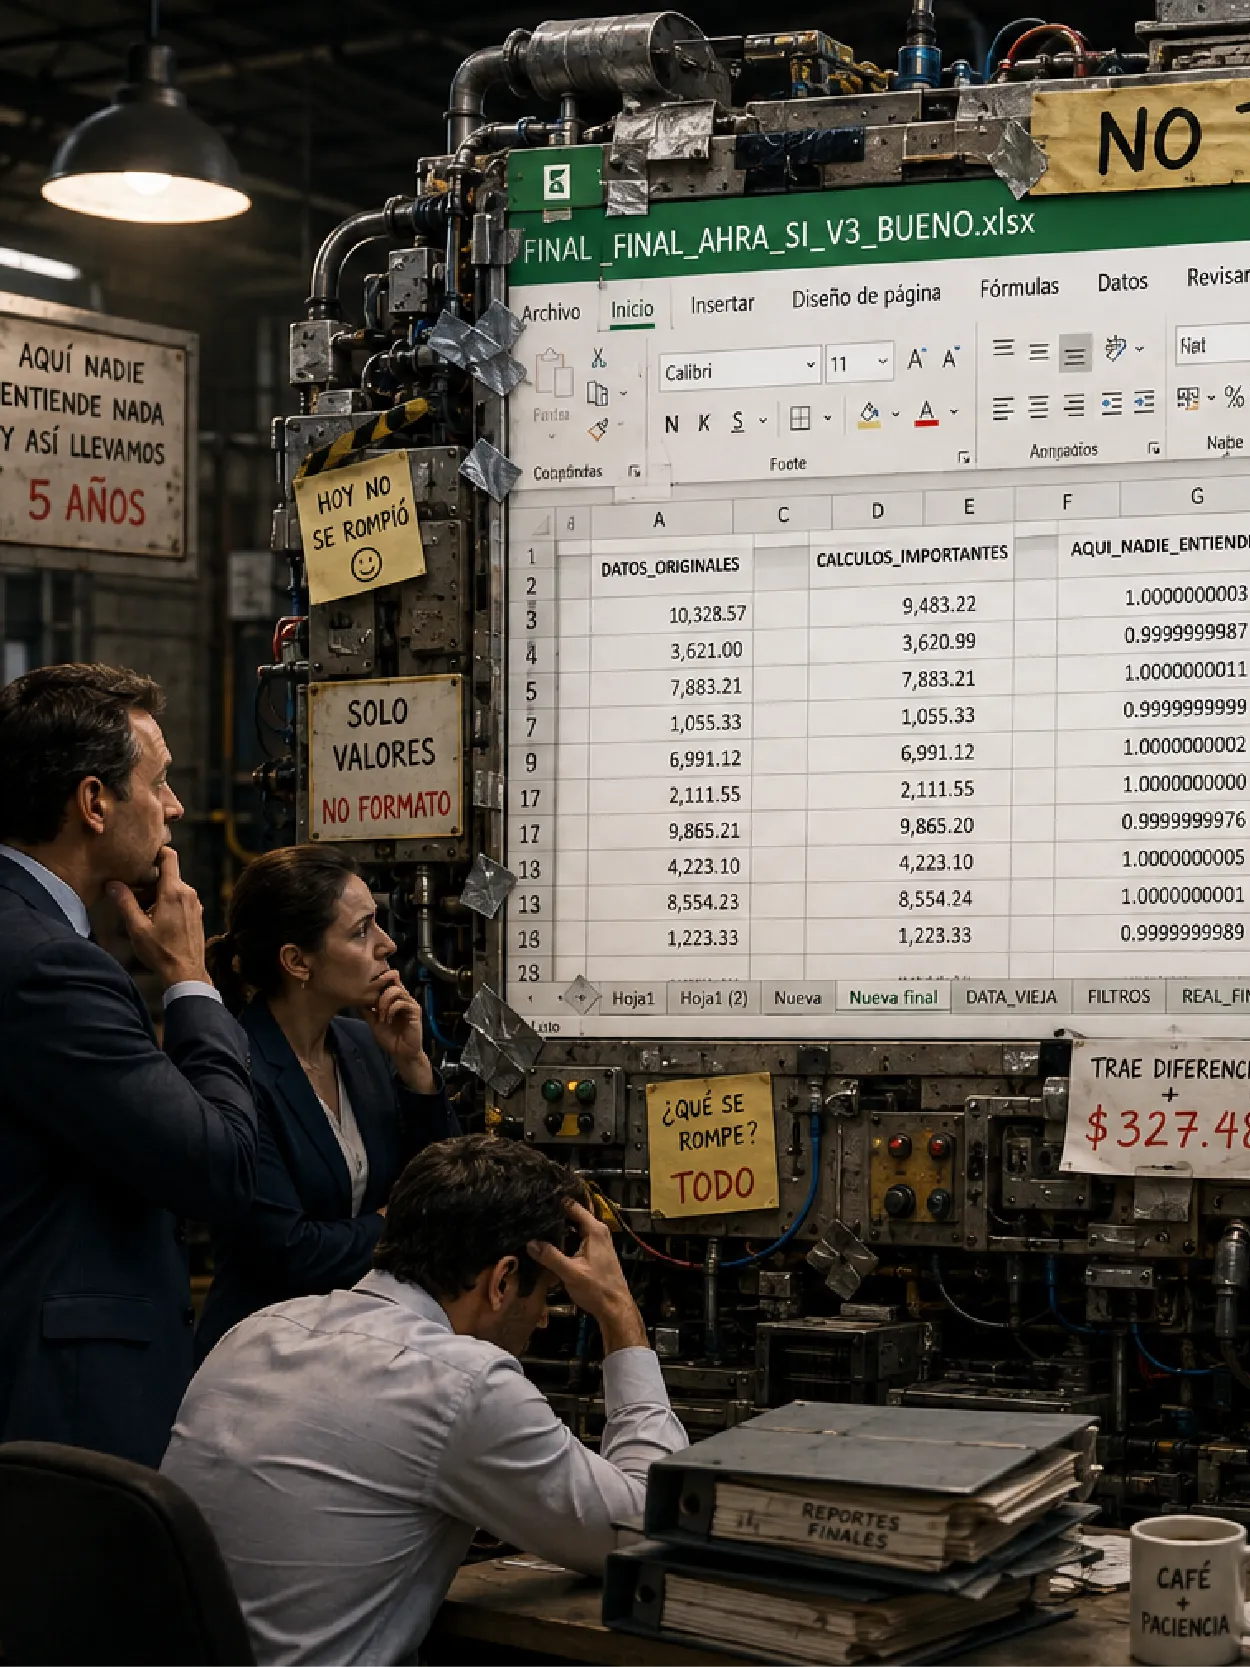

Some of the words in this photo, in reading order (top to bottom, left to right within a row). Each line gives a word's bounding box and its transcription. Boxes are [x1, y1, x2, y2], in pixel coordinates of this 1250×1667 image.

[1099, 106, 1203, 175] NO
[524, 237, 592, 264] FINAL
[523, 303, 581, 323] Archivo
[612, 299, 653, 317] Inicio
[692, 296, 754, 314] Insertar
[793, 289, 851, 309] Diseño
[858, 287, 878, 306] de
[884, 284, 940, 307] página
[981, 278, 1059, 299] Fórmulas
[1099, 274, 1147, 291] Datos
[1188, 266, 1250, 286] Revisar
[19, 342, 73, 373] AQUÍ
[85, 355, 144, 383] NADIE
[666, 363, 711, 380] Calibri
[831, 357, 845, 372] 11
[2, 382, 101, 418] ENTIENDE
[114, 398, 164, 426] NADA
[25, 425, 60, 454] ASÍ
[70, 434, 164, 466] LLEVAMOS
[29, 479, 50, 520] 5
[65, 476, 144, 527] AÑOS
[318, 484, 354, 514] HOY
[366, 476, 390, 499] NO
[653, 512, 665, 527] A
[779, 507, 789, 522] C
[873, 502, 884, 519] D
[965, 499, 974, 514] E
[1192, 487, 1203, 504] G
[313, 527, 334, 550] SE
[344, 500, 409, 543] ROMPIÓ
[602, 557, 739, 578] DATOS_ORIGINALES
[817, 545, 1008, 567] CALCULOS_IMPORTANTES
[670, 605, 746, 626] 10,328.57
[902, 595, 975, 616] 9,483.22
[1127, 585, 1248, 605] 1.0000000003
[671, 641, 742, 662] 3,621.00
[904, 633, 975, 654] 3,620.99
[1126, 623, 1248, 643] 0.9999999987
[671, 677, 741, 699] 7,883.21
[902, 671, 975, 691] 7,883.21
[1126, 661, 1246, 681] 1.0000000011
[347, 697, 407, 727] SOLO
[671, 714, 741, 733] 1,055.33
[902, 707, 974, 727] 1,055.33
[1124, 699, 1246, 717] 0.9999999999
[333, 737, 435, 771] VALORES
[670, 750, 741, 770] 6,991.12
[902, 743, 974, 763] 6,991.12
[1124, 737, 1246, 755] 1.0000000002
[670, 786, 741, 806] 2,111.55
[901, 780, 974, 800] 2,111.55
[1124, 773, 1246, 793] 1.0000000000
[323, 798, 349, 824] NO
[359, 791, 450, 821] FORMATO
[670, 823, 739, 841] 9,865.21
[901, 818, 974, 838] 9,865.20
[1122, 811, 1246, 829] 0.9999999976
[668, 857, 739, 877] 4,223.10
[899, 854, 974, 874] 4,223.10
[1124, 849, 1244, 867] 1.0000000005
[668, 894, 739, 914] 8,554.23
[899, 890, 972, 910] 8,554.24
[1122, 887, 1244, 904] 1.0000000001
[668, 930, 737, 948] 1,223.33
[899, 927, 970, 947] 1,223.33
[1121, 923, 1244, 942] 0.9999999989
[613, 991, 655, 1009] Hoja1
[681, 991, 722, 1009] Hoja1
[729, 991, 747, 1008] (2)
[775, 991, 822, 1004] Nueva
[850, 991, 898, 1004] Nueva
[904, 990, 937, 1004] final
[967, 990, 1058, 1008] DATA_VIEJA
[1089, 990, 1150, 1003] FILTROS
[1091, 1057, 1142, 1079] TRAE
[663, 1089, 713, 1127] ¿QUÉ
[722, 1094, 744, 1113] SE
[670, 1168, 754, 1204] TODO
[800, 1500, 902, 1534] REPORTES
[806, 1520, 890, 1552] FINALES
[1157, 1560, 1210, 1589] CAFÉ
[1142, 1609, 1233, 1637] PACIENCIA
